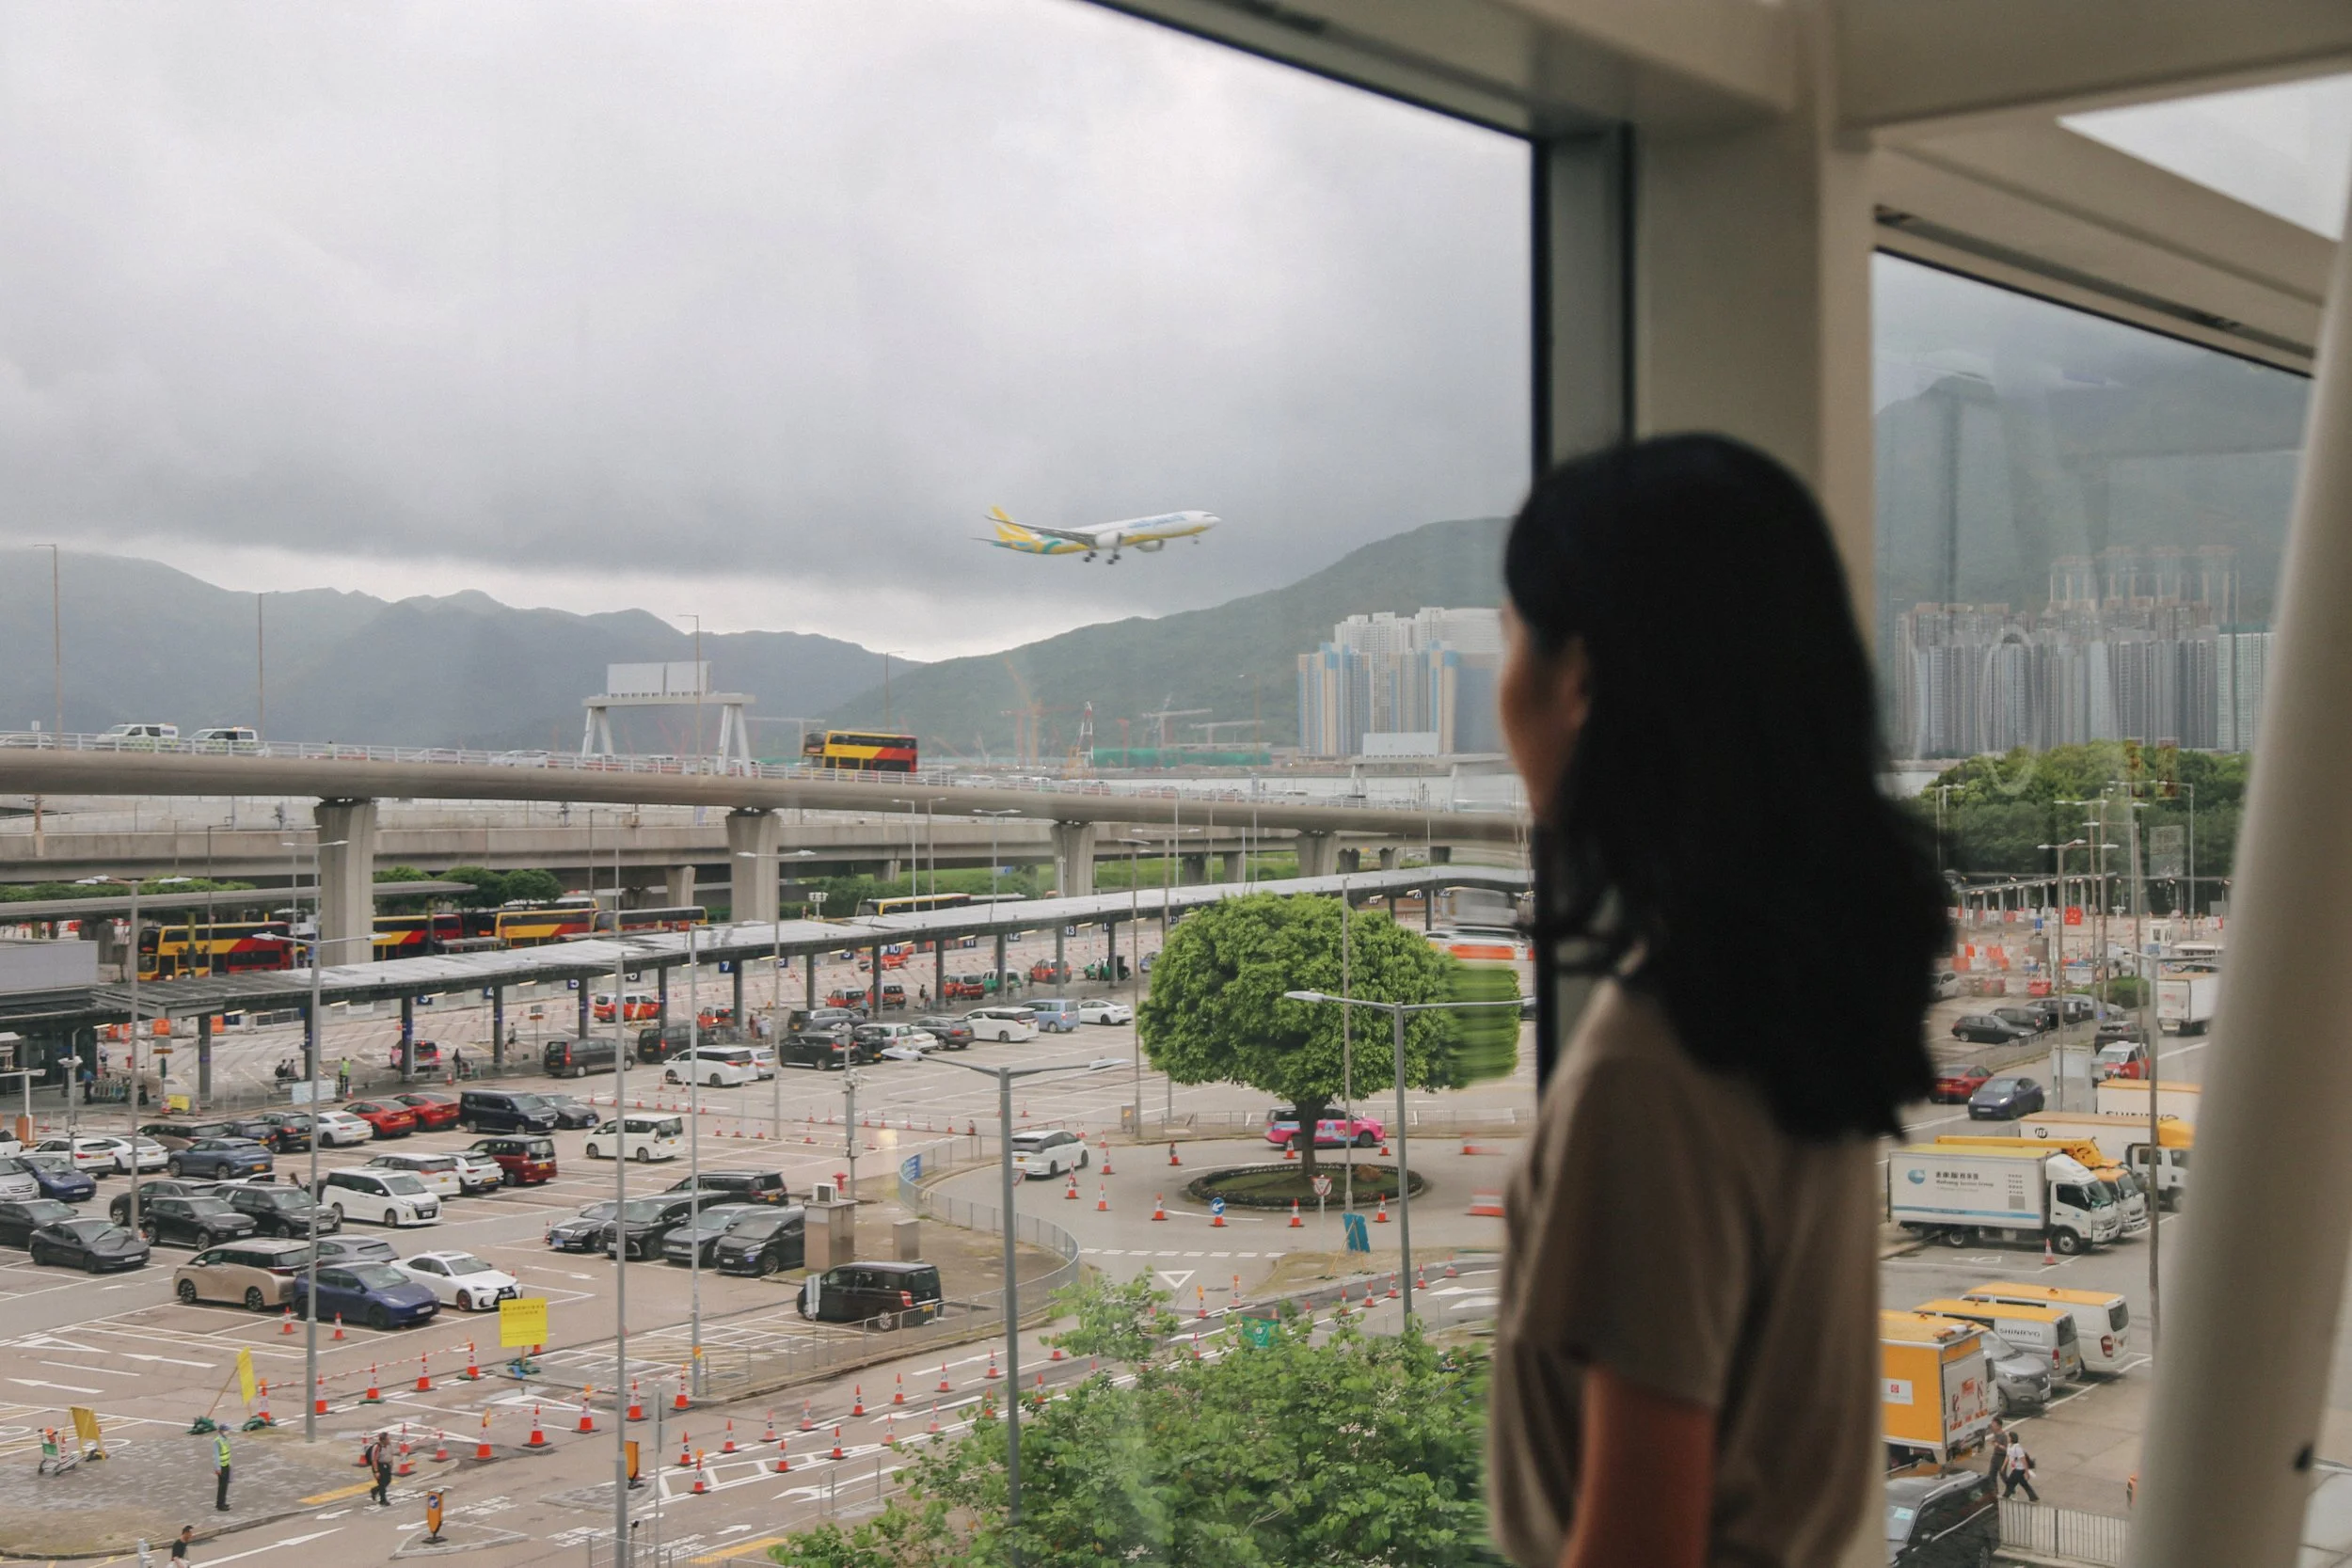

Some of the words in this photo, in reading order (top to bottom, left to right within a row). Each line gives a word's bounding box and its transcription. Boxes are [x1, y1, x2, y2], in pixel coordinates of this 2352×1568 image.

[1065, 926, 1075, 935] 13
[889, 944, 899, 954] 10
[722, 960, 730, 971] 7
[485, 986, 494, 996] 4
[1999, 1327, 2041, 1338] SHINRYO
